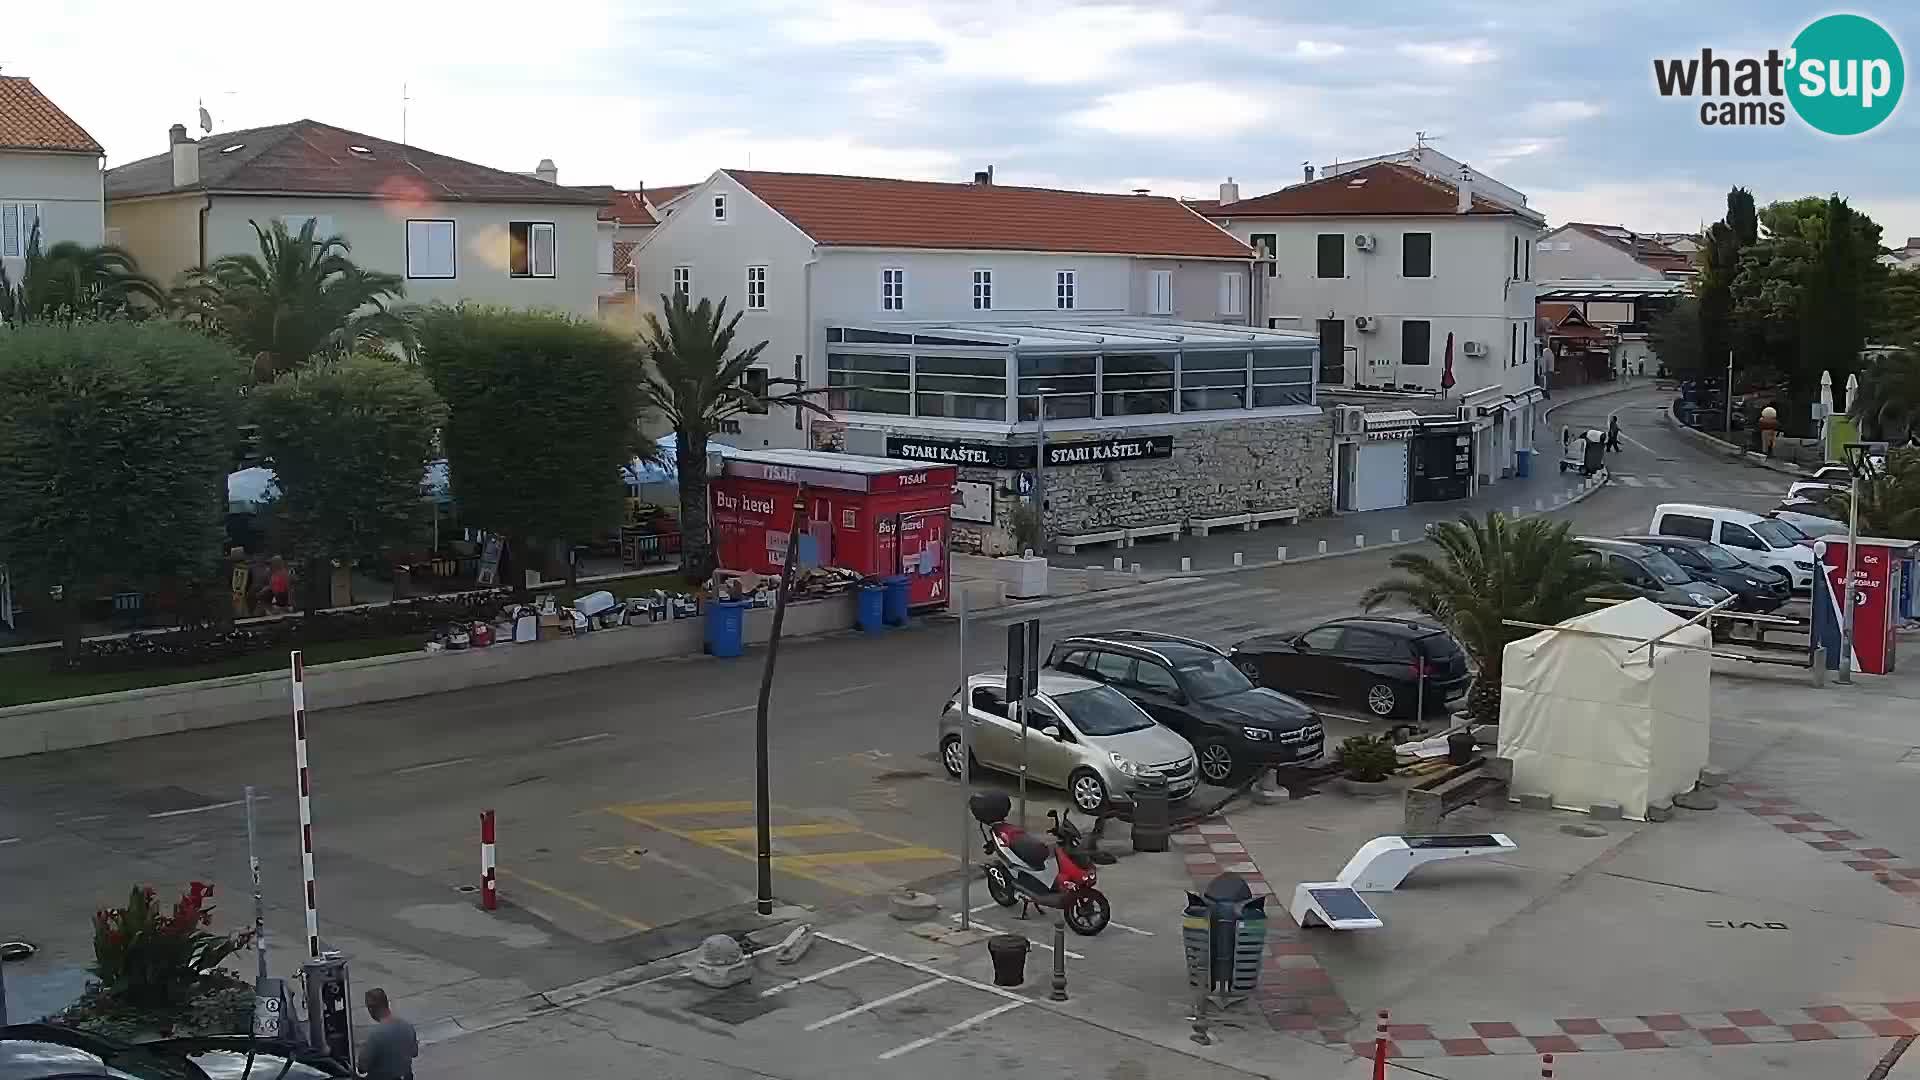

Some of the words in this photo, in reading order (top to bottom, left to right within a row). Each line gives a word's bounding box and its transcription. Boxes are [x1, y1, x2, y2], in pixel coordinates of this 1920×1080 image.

[902, 444, 938, 459] STARI
[940, 446, 990, 464] KAŠTEL
[1050, 445, 1090, 463] STARI
[1093, 440, 1143, 459] KAŠTEL
[899, 473, 927, 485] TISAK
[716, 490, 738, 509] Buy
[742, 494, 775, 515] here!
[878, 521, 897, 535] Buy
